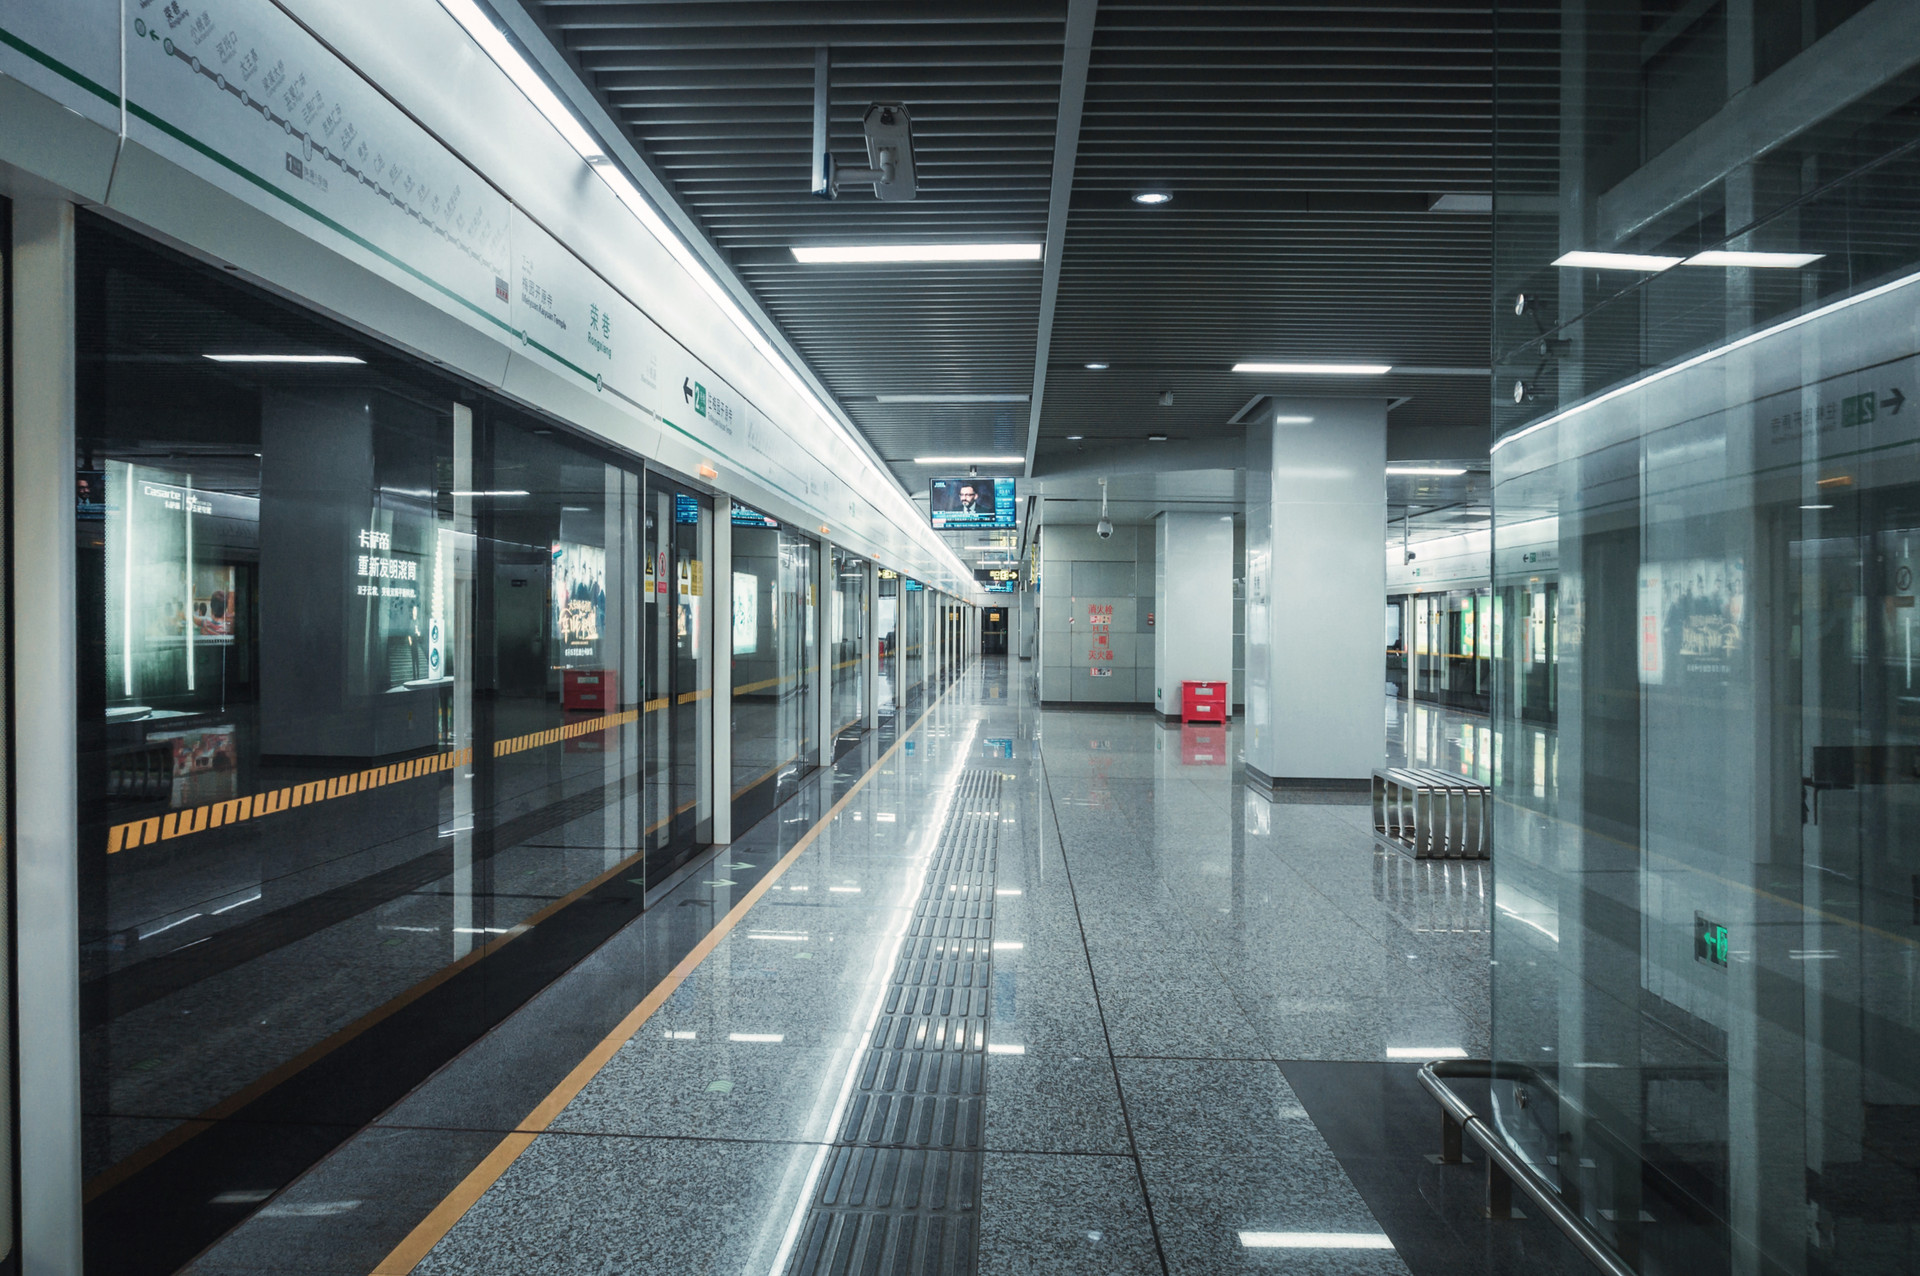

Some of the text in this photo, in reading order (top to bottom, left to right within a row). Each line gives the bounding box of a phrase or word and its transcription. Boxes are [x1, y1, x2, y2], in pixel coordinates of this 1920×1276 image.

[590, 302, 611, 340] 荣巷
[587, 331, 612, 359] Rongxiang
[144, 485, 181, 500] Casarte
[358, 528, 390, 551] 卡萨帝
[357, 555, 417, 581] 重新发明滚筒
[1088, 604, 1113, 615] 消火栓
[1089, 650, 1113, 660] 灭火器
